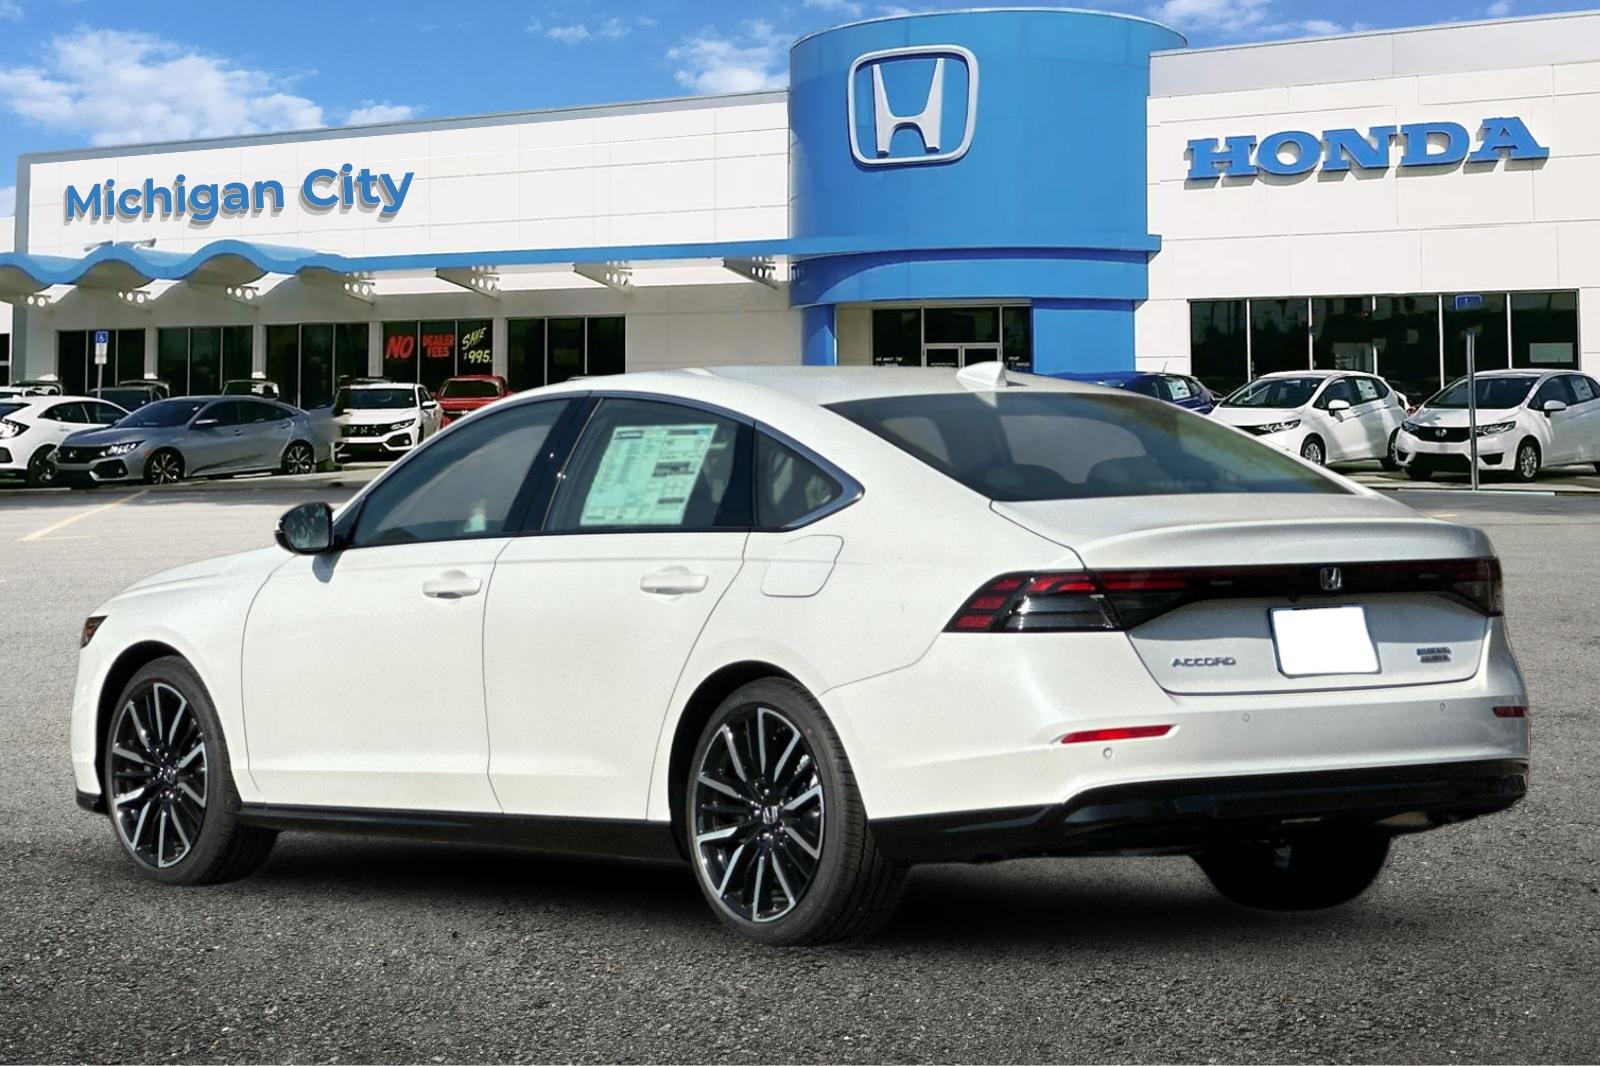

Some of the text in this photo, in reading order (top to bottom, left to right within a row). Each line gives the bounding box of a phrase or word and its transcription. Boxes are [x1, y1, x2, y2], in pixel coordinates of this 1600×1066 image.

[1186, 117, 1550, 181] HONDA
[66, 163, 415, 223] Michigan City
[385, 335, 415, 360] NO
[461, 327, 487, 350] SAVE
[1172, 657, 1237, 667] ACCORD
